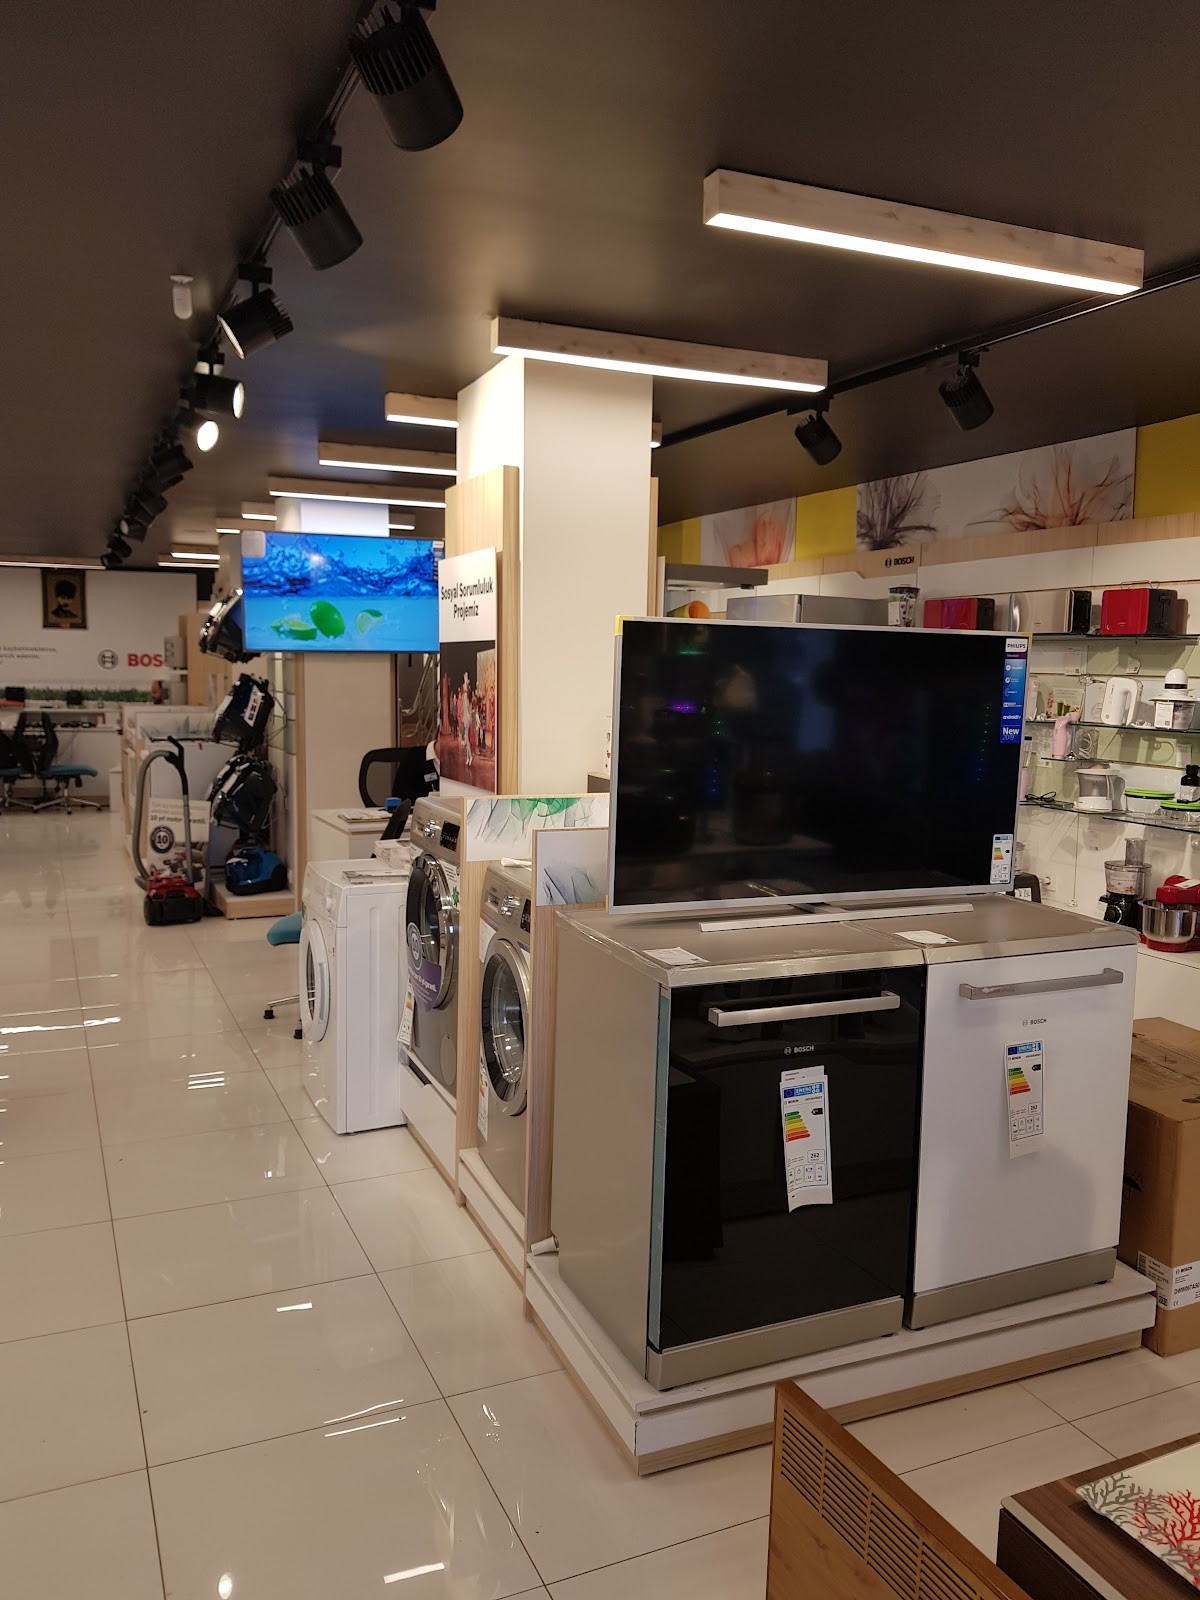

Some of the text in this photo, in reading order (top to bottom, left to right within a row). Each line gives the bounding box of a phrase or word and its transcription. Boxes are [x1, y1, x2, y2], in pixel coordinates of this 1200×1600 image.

[893, 556, 915, 566] BOSCH
[441, 577, 493, 602] Sosyal Sorumluluk
[454, 601, 478, 621] Projemiz
[1002, 727, 1020, 735] New
[157, 834, 168, 845] 10
[793, 1045, 815, 1053] BOSCH
